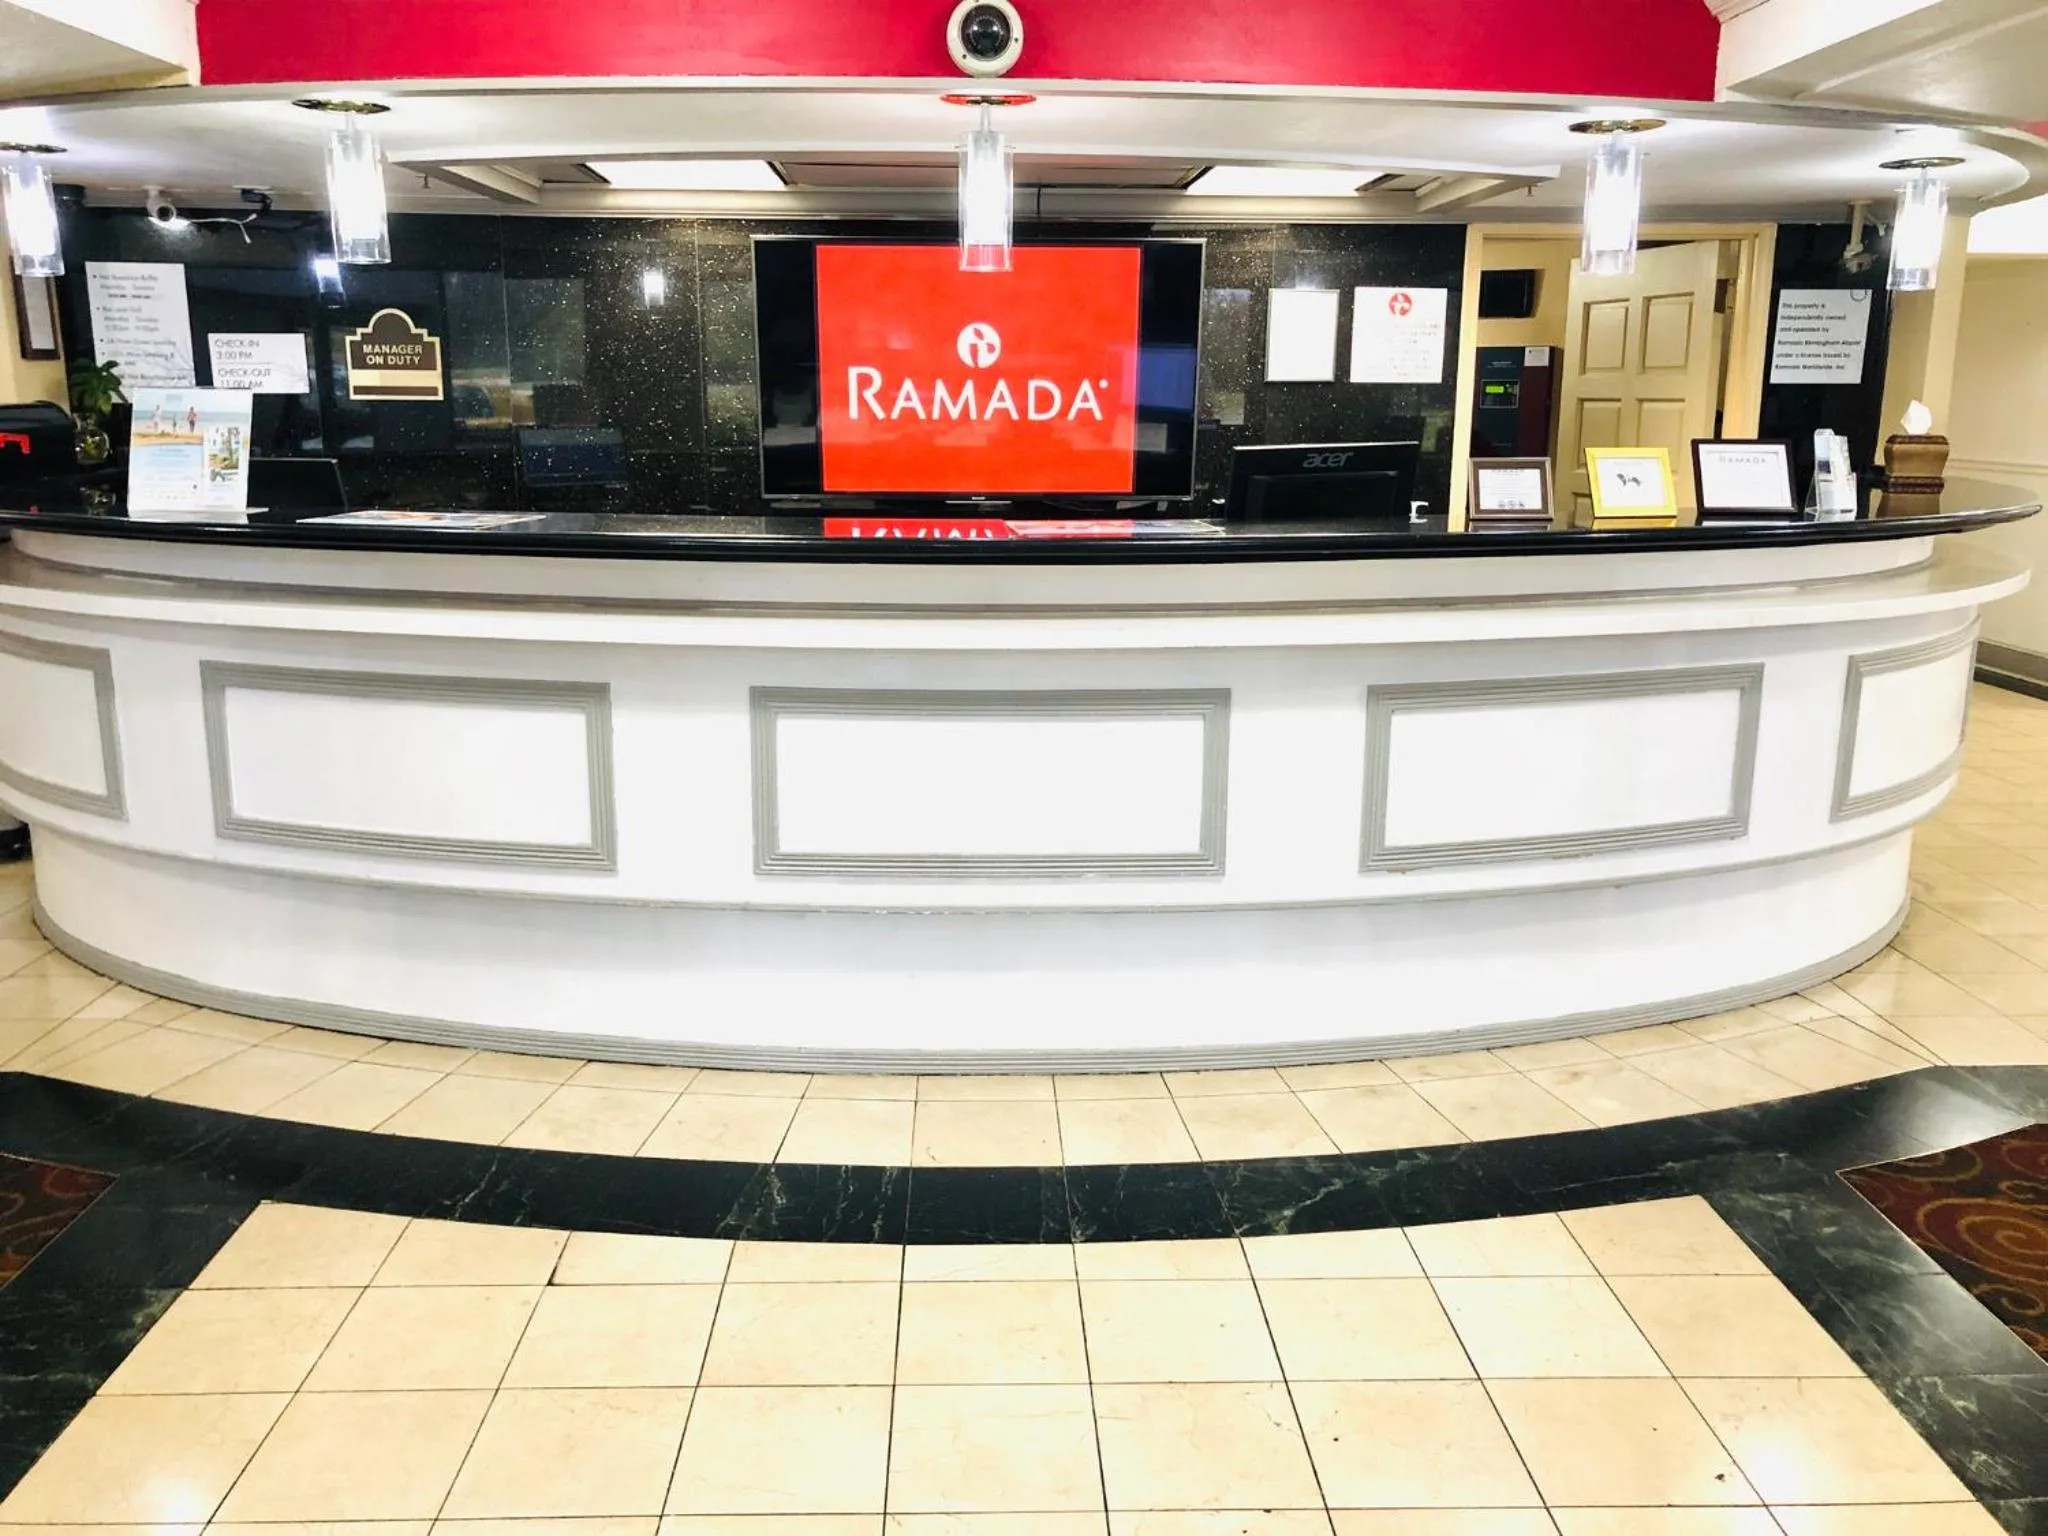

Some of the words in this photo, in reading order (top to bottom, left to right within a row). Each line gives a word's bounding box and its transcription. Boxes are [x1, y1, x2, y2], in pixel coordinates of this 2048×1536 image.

[362, 344, 423, 355] MANAGER
[238, 350, 252, 360] PM
[366, 355, 384, 365] ON
[387, 355, 421, 365] DUTY
[248, 379, 264, 389] AM
[847, 365, 1105, 421] RAMADA
[1303, 451, 1354, 468] acer
